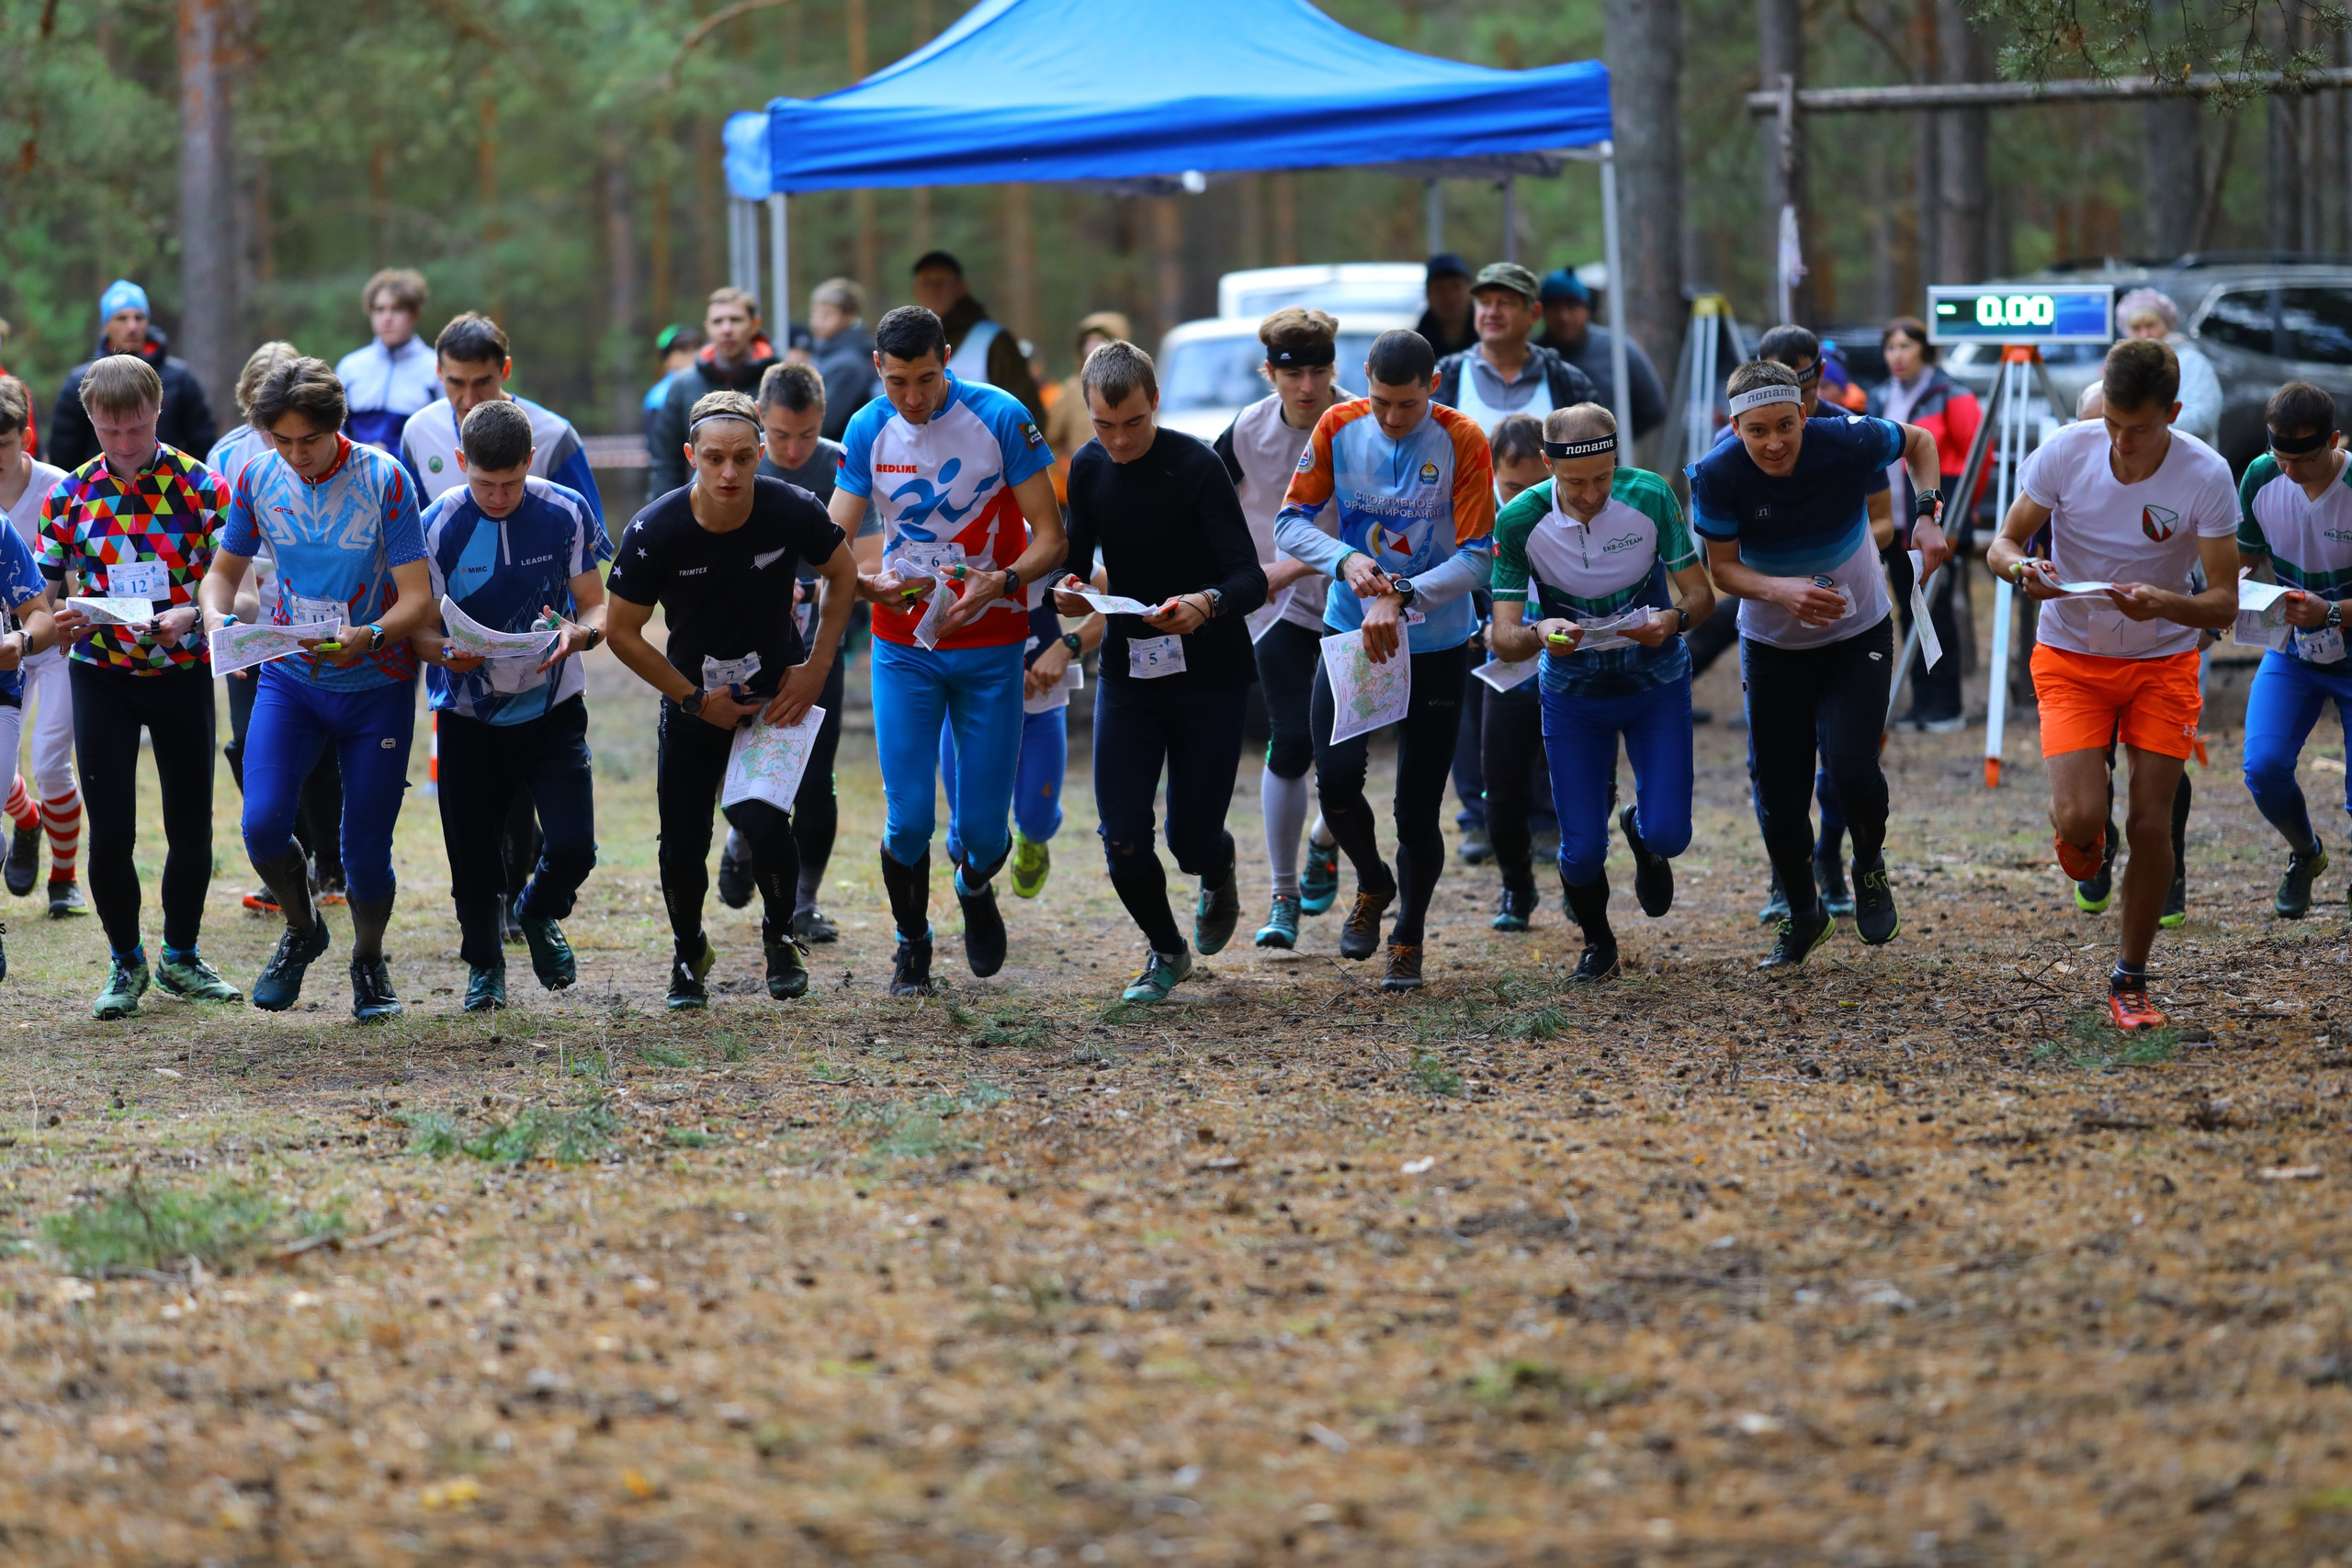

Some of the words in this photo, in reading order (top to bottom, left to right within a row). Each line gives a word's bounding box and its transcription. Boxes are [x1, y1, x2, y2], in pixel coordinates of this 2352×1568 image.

[1976, 295, 2054, 326] 0.00
[1747, 389, 1795, 404] noname
[1566, 439, 1614, 455] noname
[876, 464, 917, 473] REDLINE
[1354, 491, 1434, 508] СПОРТИВНОЕ
[1344, 501, 1444, 518] ОРИЕНТИРОВАНИЕ
[1602, 536, 1644, 553] EKB-O-TEAM
[521, 554, 553, 566] LEADER
[932, 556, 940, 568] 6
[678, 566, 707, 577] TRIMTEX
[130, 580, 147, 593] 12
[2111, 618, 2124, 646] 1
[2310, 643, 2324, 654] 21
[1149, 652, 1158, 665] 5
[727, 671, 734, 680] 7
